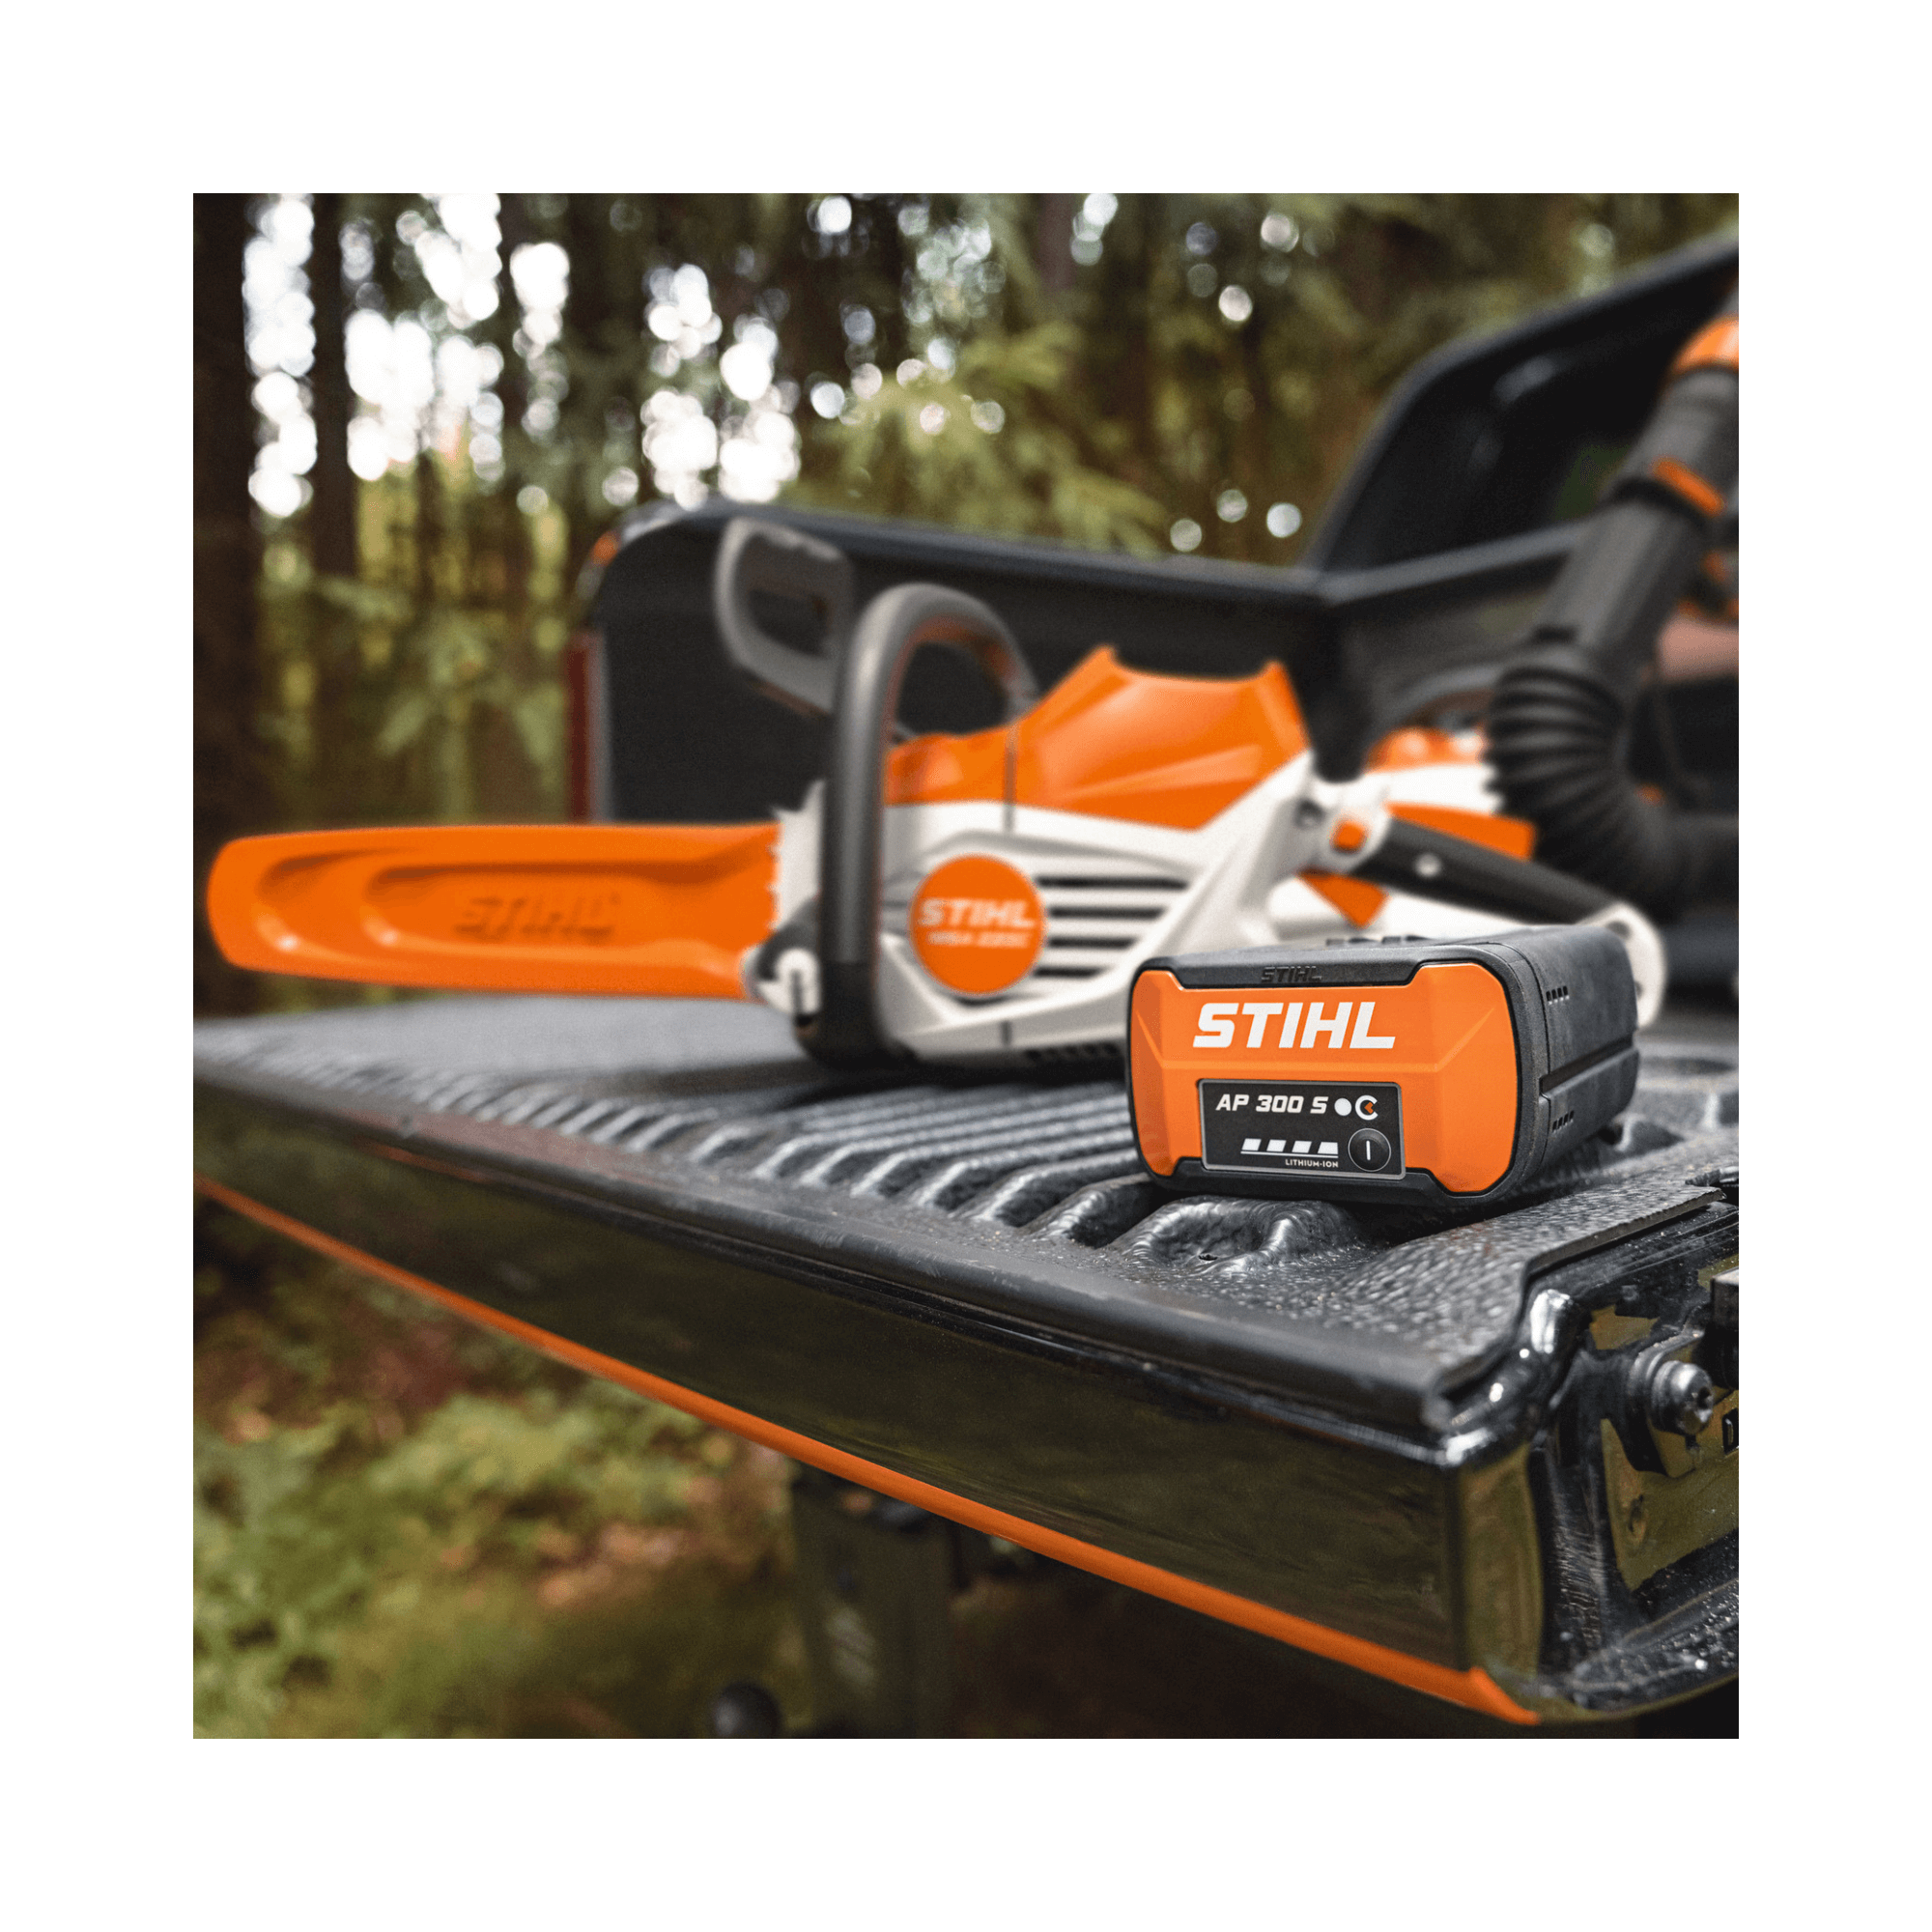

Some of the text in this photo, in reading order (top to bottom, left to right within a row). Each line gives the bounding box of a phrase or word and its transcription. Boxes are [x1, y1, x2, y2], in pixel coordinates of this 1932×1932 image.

[918, 897, 1035, 928] STIHL
[1261, 965, 1322, 983] STIHL
[1192, 1002, 1396, 1049] STIHL
[1215, 1094, 1250, 1112] AP
[1256, 1094, 1304, 1114] 300
[1310, 1095, 1329, 1115] S
[1285, 1158, 1339, 1168] LITHIUM-ION
